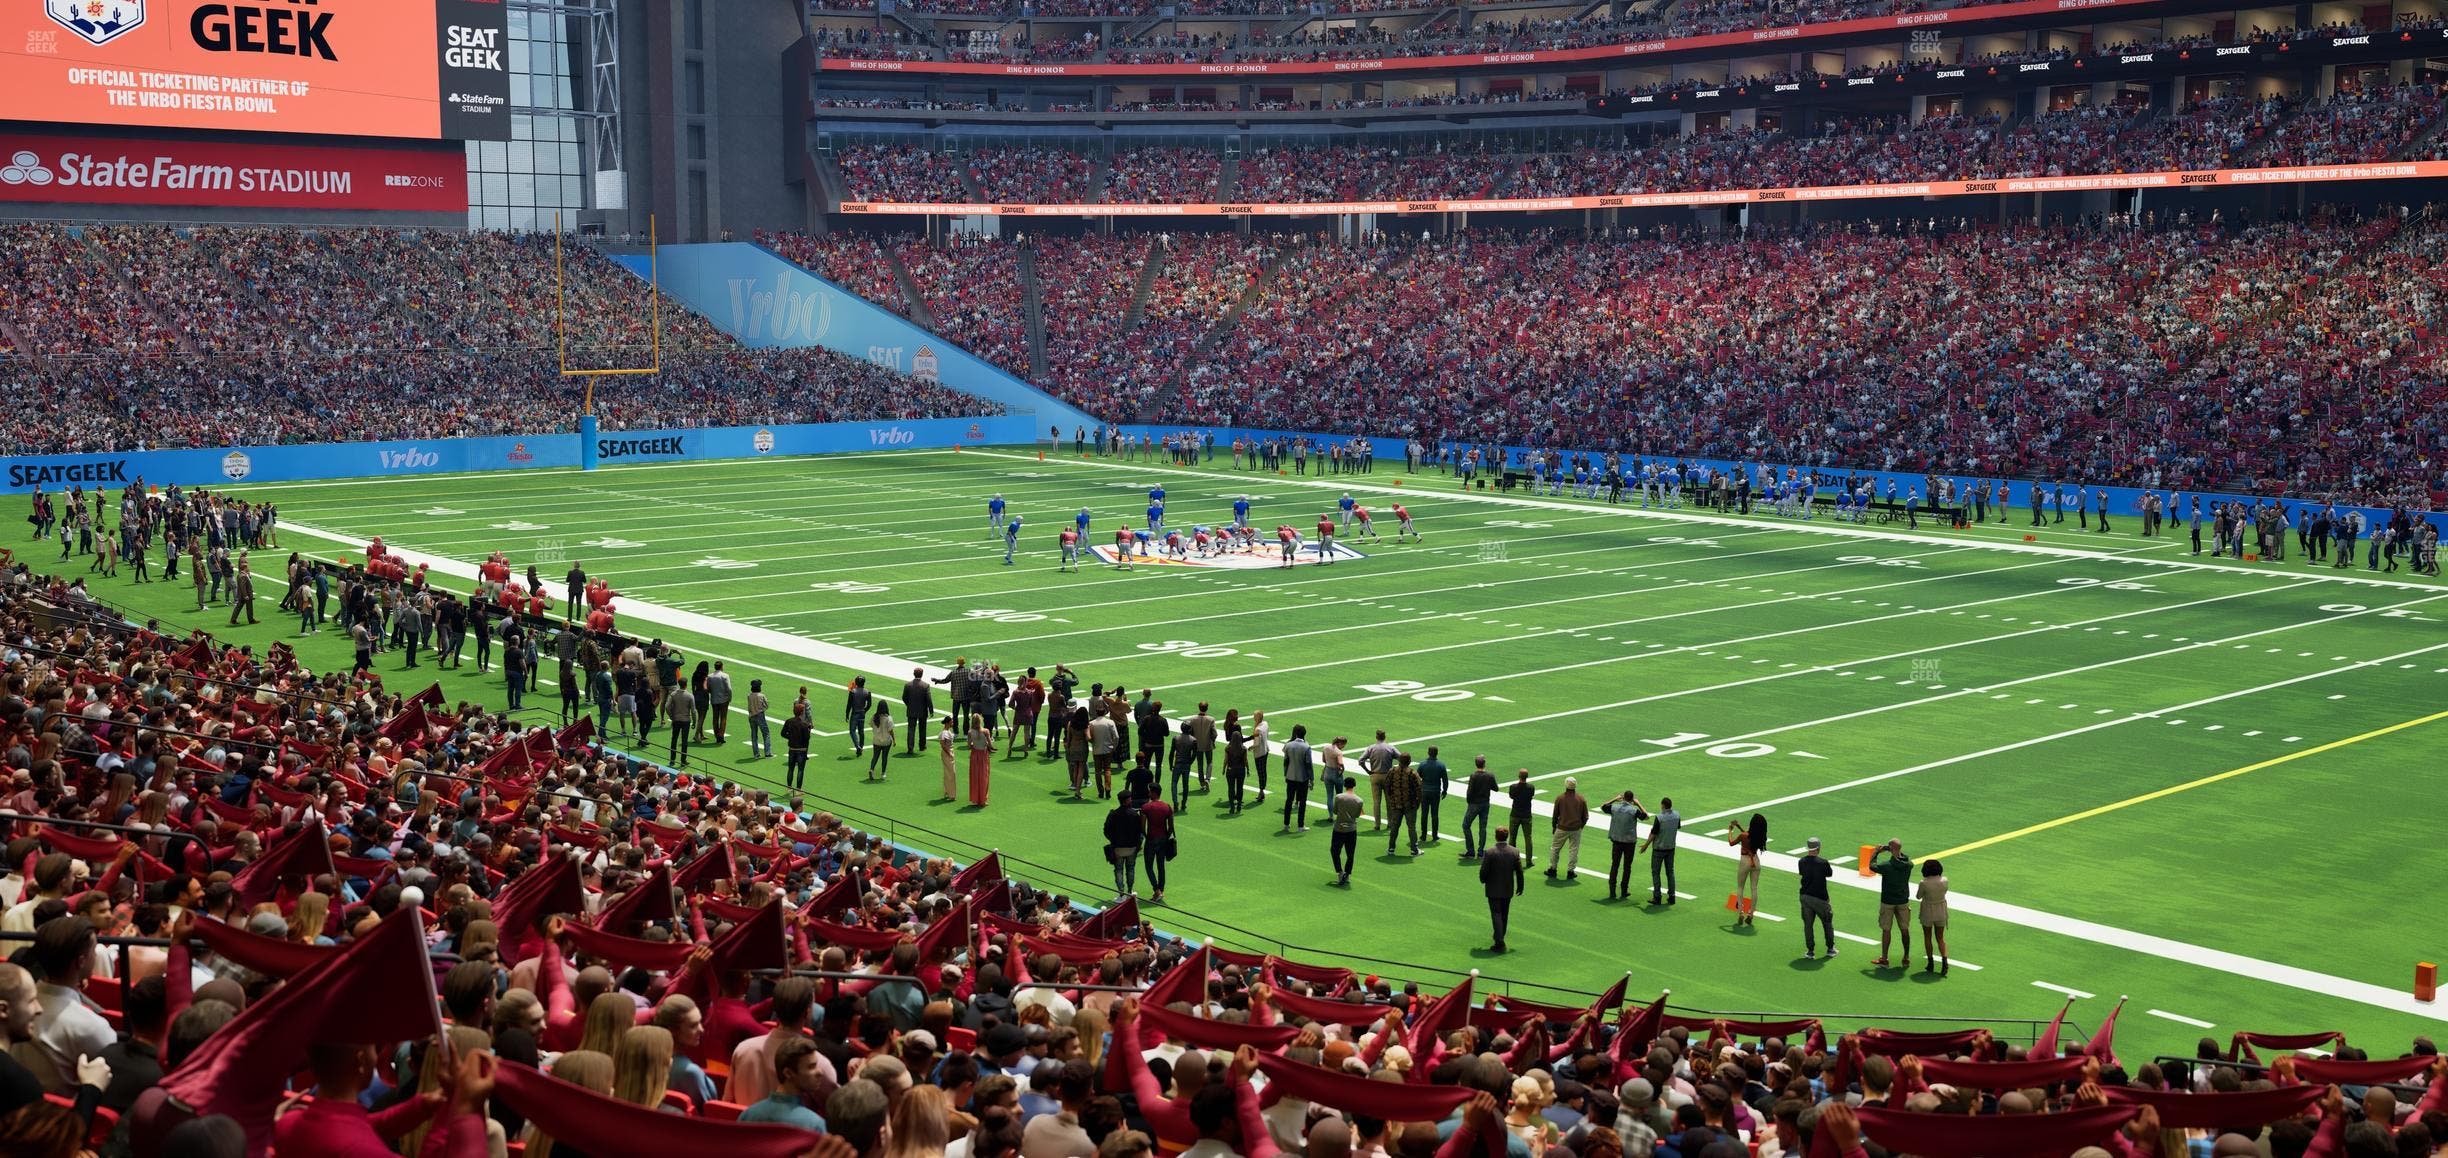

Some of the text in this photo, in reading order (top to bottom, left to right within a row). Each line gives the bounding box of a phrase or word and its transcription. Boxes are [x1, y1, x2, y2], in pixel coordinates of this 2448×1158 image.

[1914, 15, 1923, 23] OF
[1924, 13, 1948, 22] HONOR
[190, 4, 338, 62] GEEK
[447, 25, 498, 48] SEAT
[2333, 36, 2370, 46] SEATGEEK
[445, 47, 502, 71] GEEK
[2121, 54, 2153, 63] SEATGEEK
[2217, 46, 2250, 56] SEATGEEK
[1937, 70, 1964, 78] SEATGEEK
[2020, 62, 2050, 72] SEATGEEK
[68, 68, 309, 96] OFFICIAL TICKETING PARTNER OF
[1775, 83, 1799, 92] SEATGEEK
[1848, 77, 1874, 86] SEATGEEK
[107, 89, 277, 113] THE VRBO FIESTA BOWL
[462, 105, 491, 113] STADIUM
[239, 168, 352, 194] STADIUM
[385, 175, 444, 188] REDZONE
[2181, 174, 2216, 184] SEATGEEK
[2232, 173, 2260, 181] OFFICIAL
[2261, 171, 2296, 180] TICKETING
[2297, 170, 2327, 178] PARTNER
[2329, 169, 2339, 177] OF
[2371, 167, 2395, 175] FIESTA
[2397, 166, 2417, 174] BOWL
[1966, 182, 1996, 191] SEATGEEK
[1759, 191, 1785, 200] SEATGEEK
[728, 270, 831, 341] Vrbo
[869, 345, 903, 370] SEAT
[869, 427, 914, 444] Vrbo
[598, 436, 685, 459] SEATGEEK
[379, 446, 439, 469] Vrbo
[9, 460, 128, 487] SEATGEEK
[1137, 640, 1239, 658] 30
[1352, 680, 1476, 702] 20
[1640, 732, 1776, 757] 10
